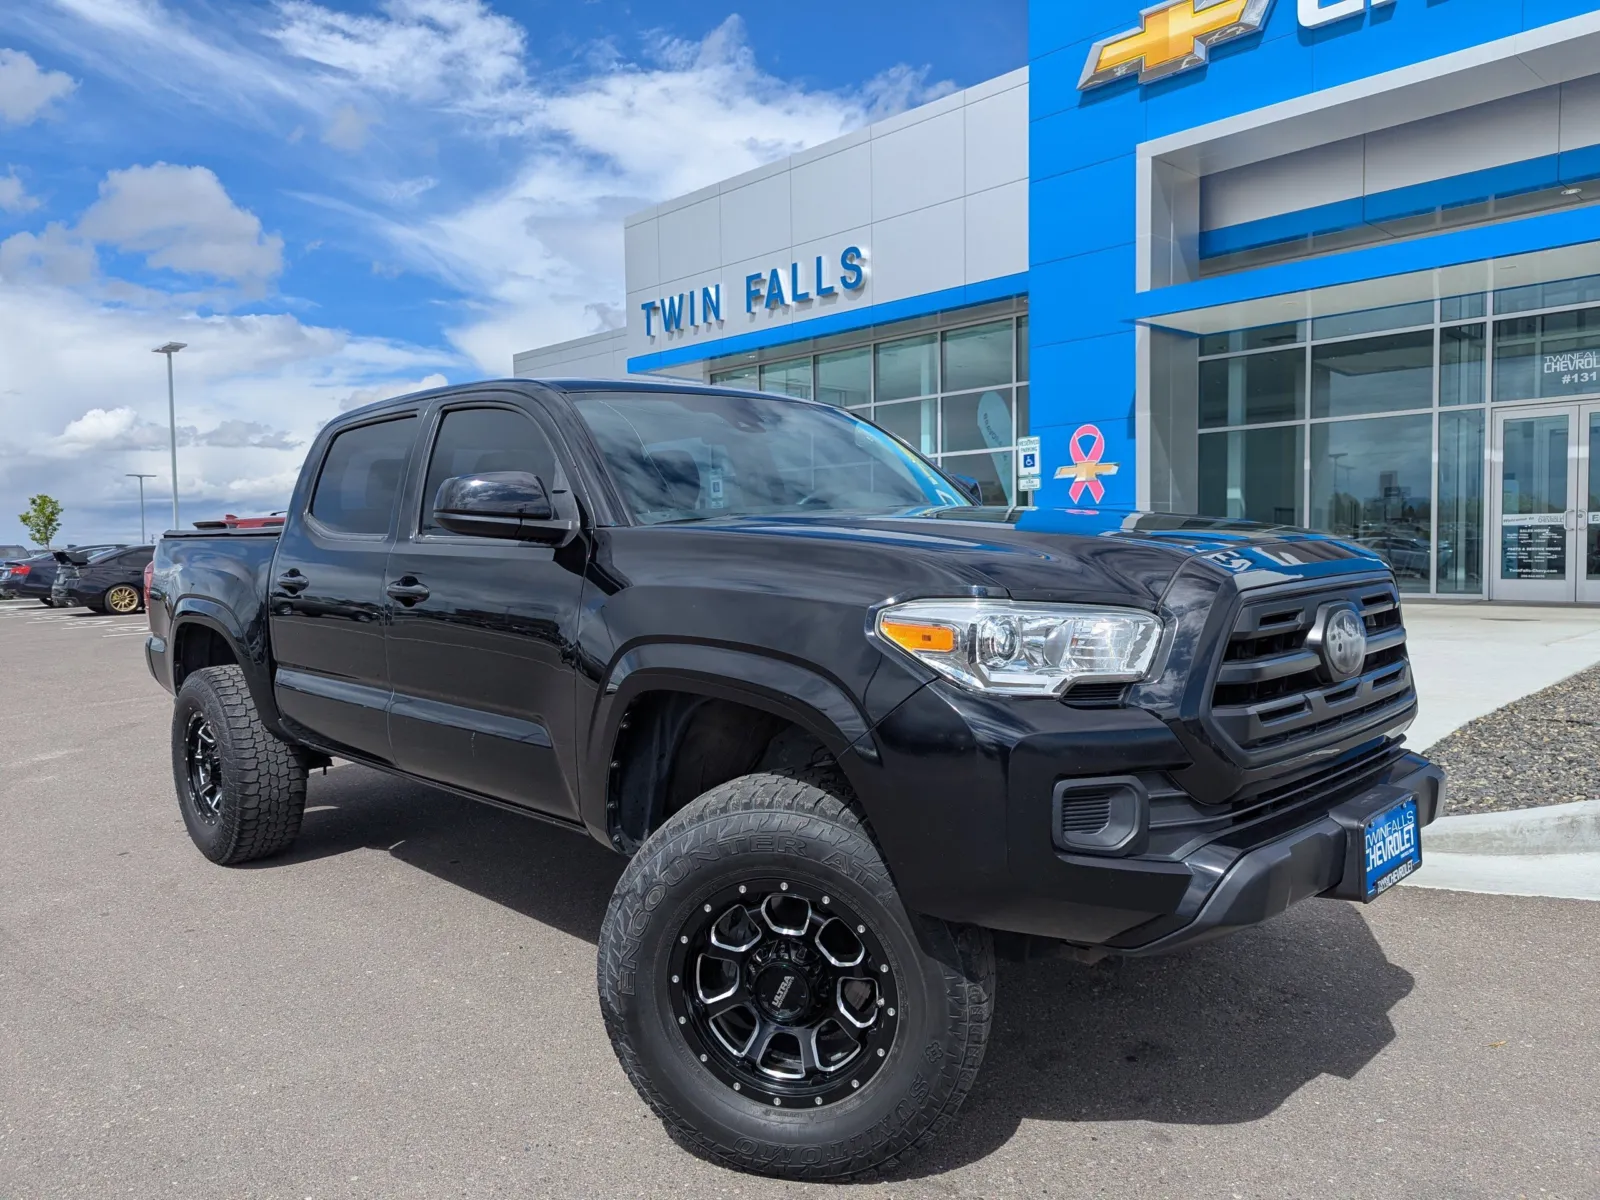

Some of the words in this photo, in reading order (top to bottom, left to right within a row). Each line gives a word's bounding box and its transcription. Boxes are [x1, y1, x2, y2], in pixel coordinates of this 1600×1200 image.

[641, 284, 722, 337] TWIN
[745, 246, 866, 314] FALLS
[1561, 371, 1597, 385] #131
[620, 834, 808, 996] ENCOUNTER
[822, 853, 880, 886] AT
[771, 975, 792, 1006] ULTRA
